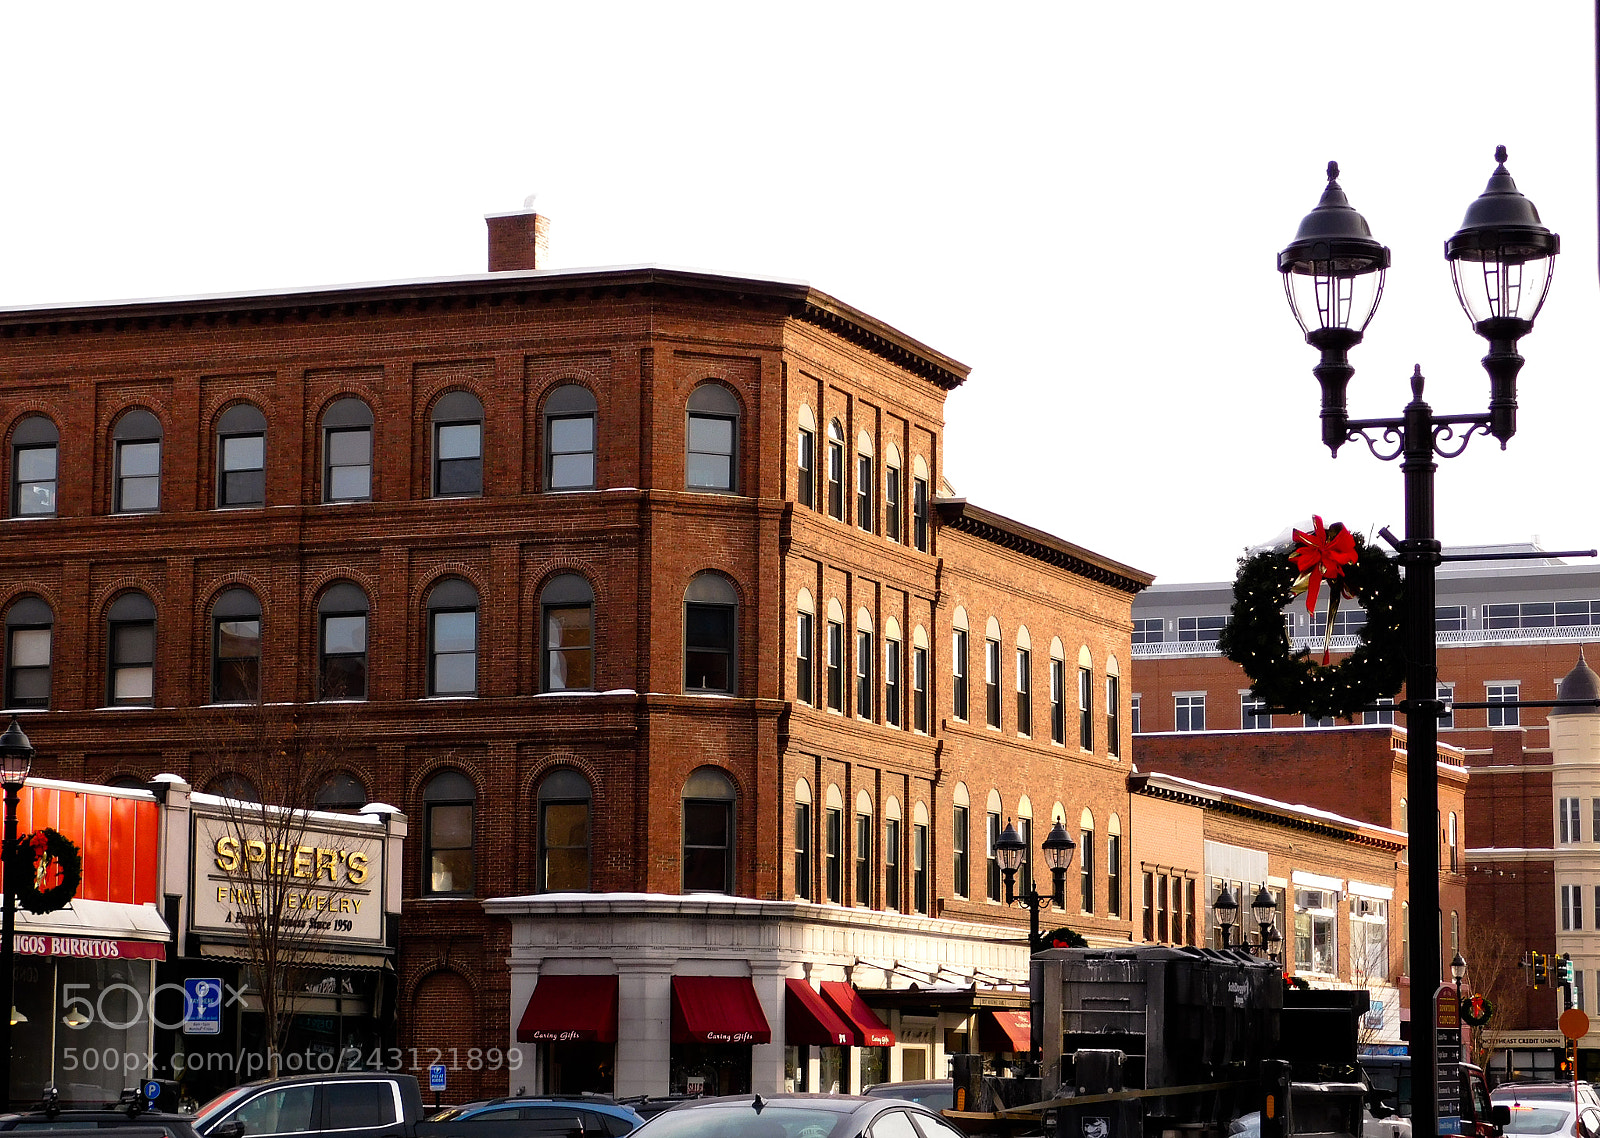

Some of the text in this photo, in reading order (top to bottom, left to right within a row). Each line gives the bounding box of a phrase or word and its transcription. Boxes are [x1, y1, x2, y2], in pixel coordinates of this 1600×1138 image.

[215, 836, 370, 884] SPEER'S
[217, 887, 262, 906] FINE
[225, 911, 232, 922] A
[333, 919, 353, 931] 1950
[51, 937, 119, 957] BURRITOS
[533, 1030, 580, 1041] Caring Gifts
[707, 1031, 753, 1042] Caring Gifts
